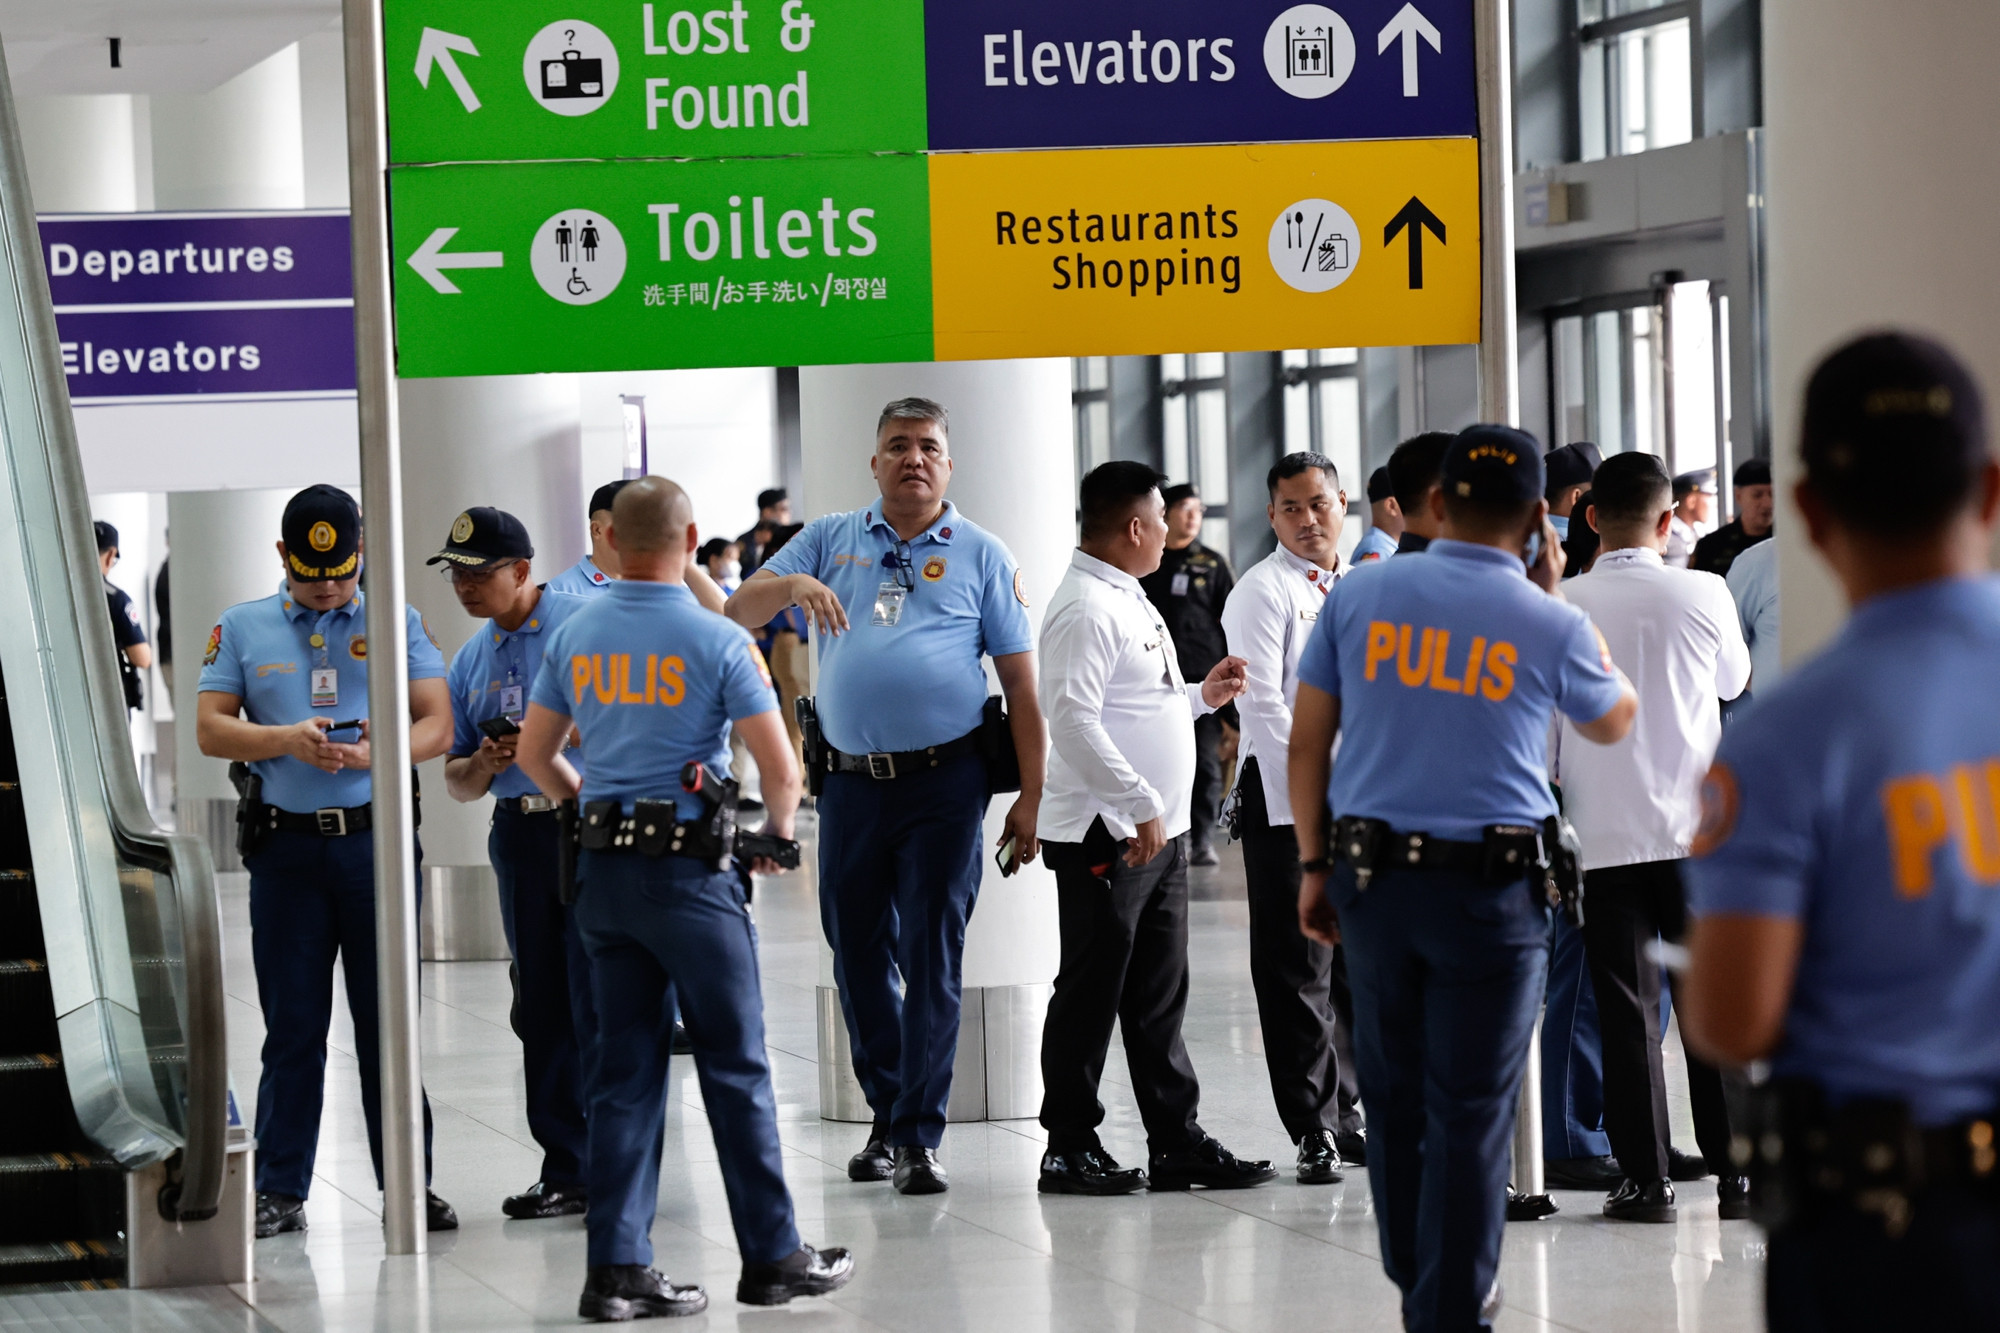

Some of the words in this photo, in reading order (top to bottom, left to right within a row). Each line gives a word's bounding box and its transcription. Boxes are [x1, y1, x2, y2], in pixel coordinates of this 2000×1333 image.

[642, 0, 750, 56] Lost
[780, 0, 816, 53] &
[983, 29, 1237, 87] Elevators
[645, 70, 810, 131] Found
[647, 195, 879, 262] Toilets
[996, 204, 1239, 246] Restaurants
[50, 242, 295, 283] Departures
[1051, 249, 1242, 297] Shopping
[60, 341, 261, 375] Elevators
[1467, 444, 1518, 466] PULIS
[571, 652, 686, 707] PULIS
[1365, 620, 1519, 702] PULIS
